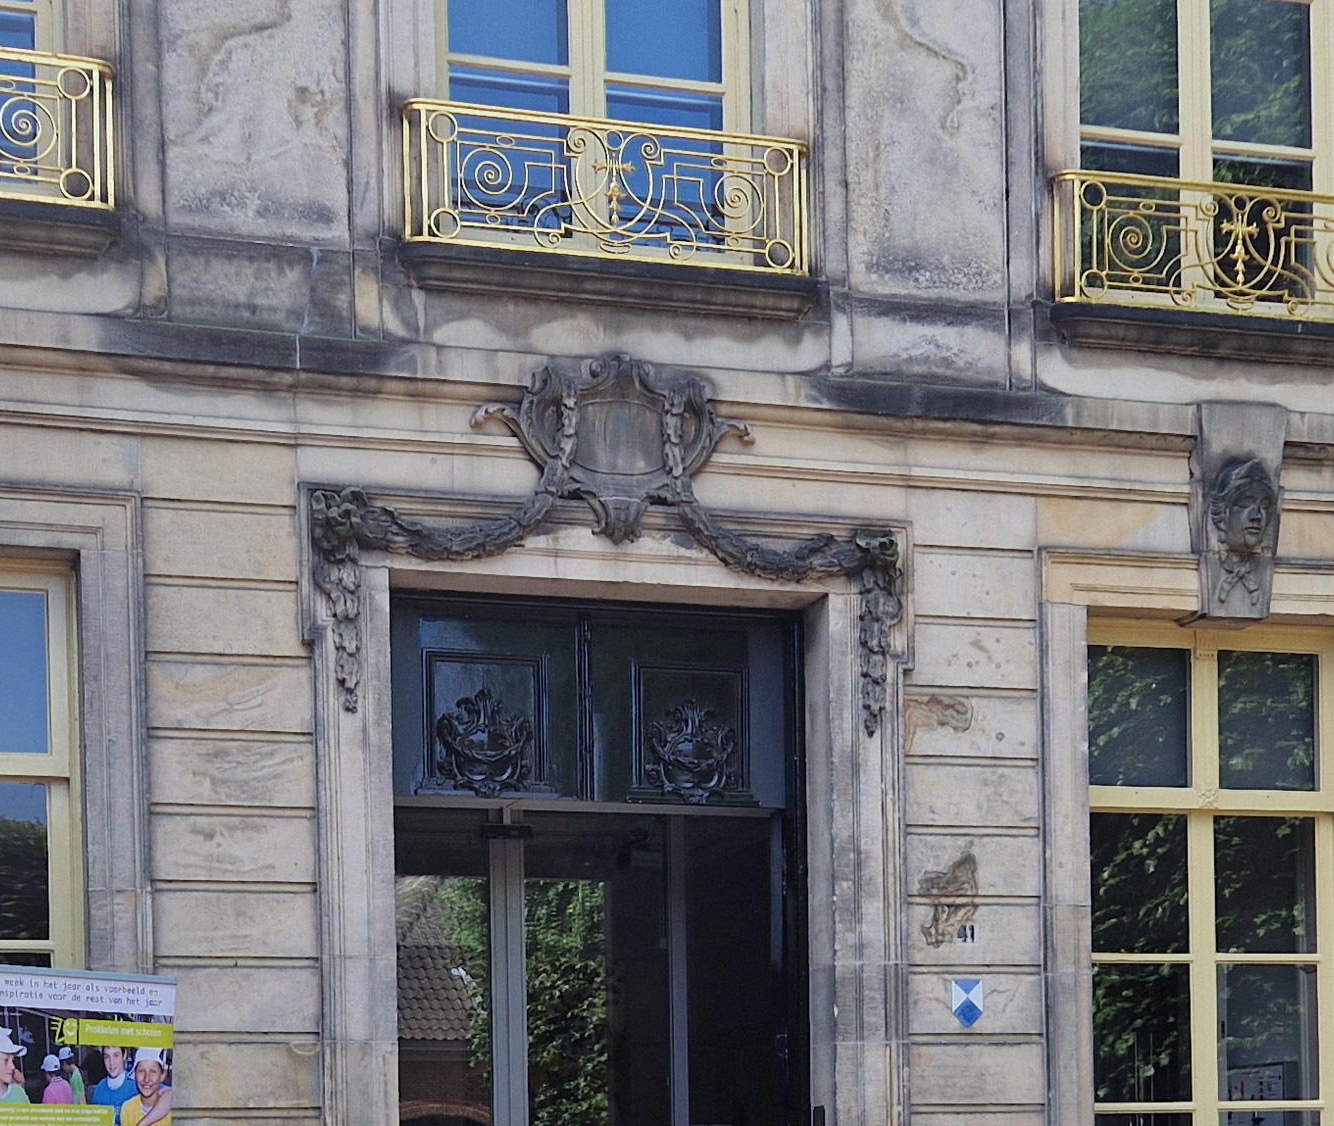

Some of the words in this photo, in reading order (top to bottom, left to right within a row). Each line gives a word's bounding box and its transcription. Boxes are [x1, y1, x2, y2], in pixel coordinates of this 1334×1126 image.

[957, 924, 975, 943] 41
[4, 978, 24, 987] week
[29, 979, 39, 988] in
[43, 980, 58, 990] het
[62, 982, 81, 992] jaar
[85, 983, 100, 993] als
[104, 985, 145, 995] voorbeeld
[47, 993, 67, 1001] voor
[71, 993, 81, 1002] de
[85, 995, 104, 1004] rest
[108, 996, 123, 1004] van
[126, 996, 140, 1005] het
[145, 999, 163, 1008] jaar
[85, 1023, 120, 1036] Prokkelen
[121, 1026, 134, 1036] met
[136, 1027, 162, 1038] scholen
